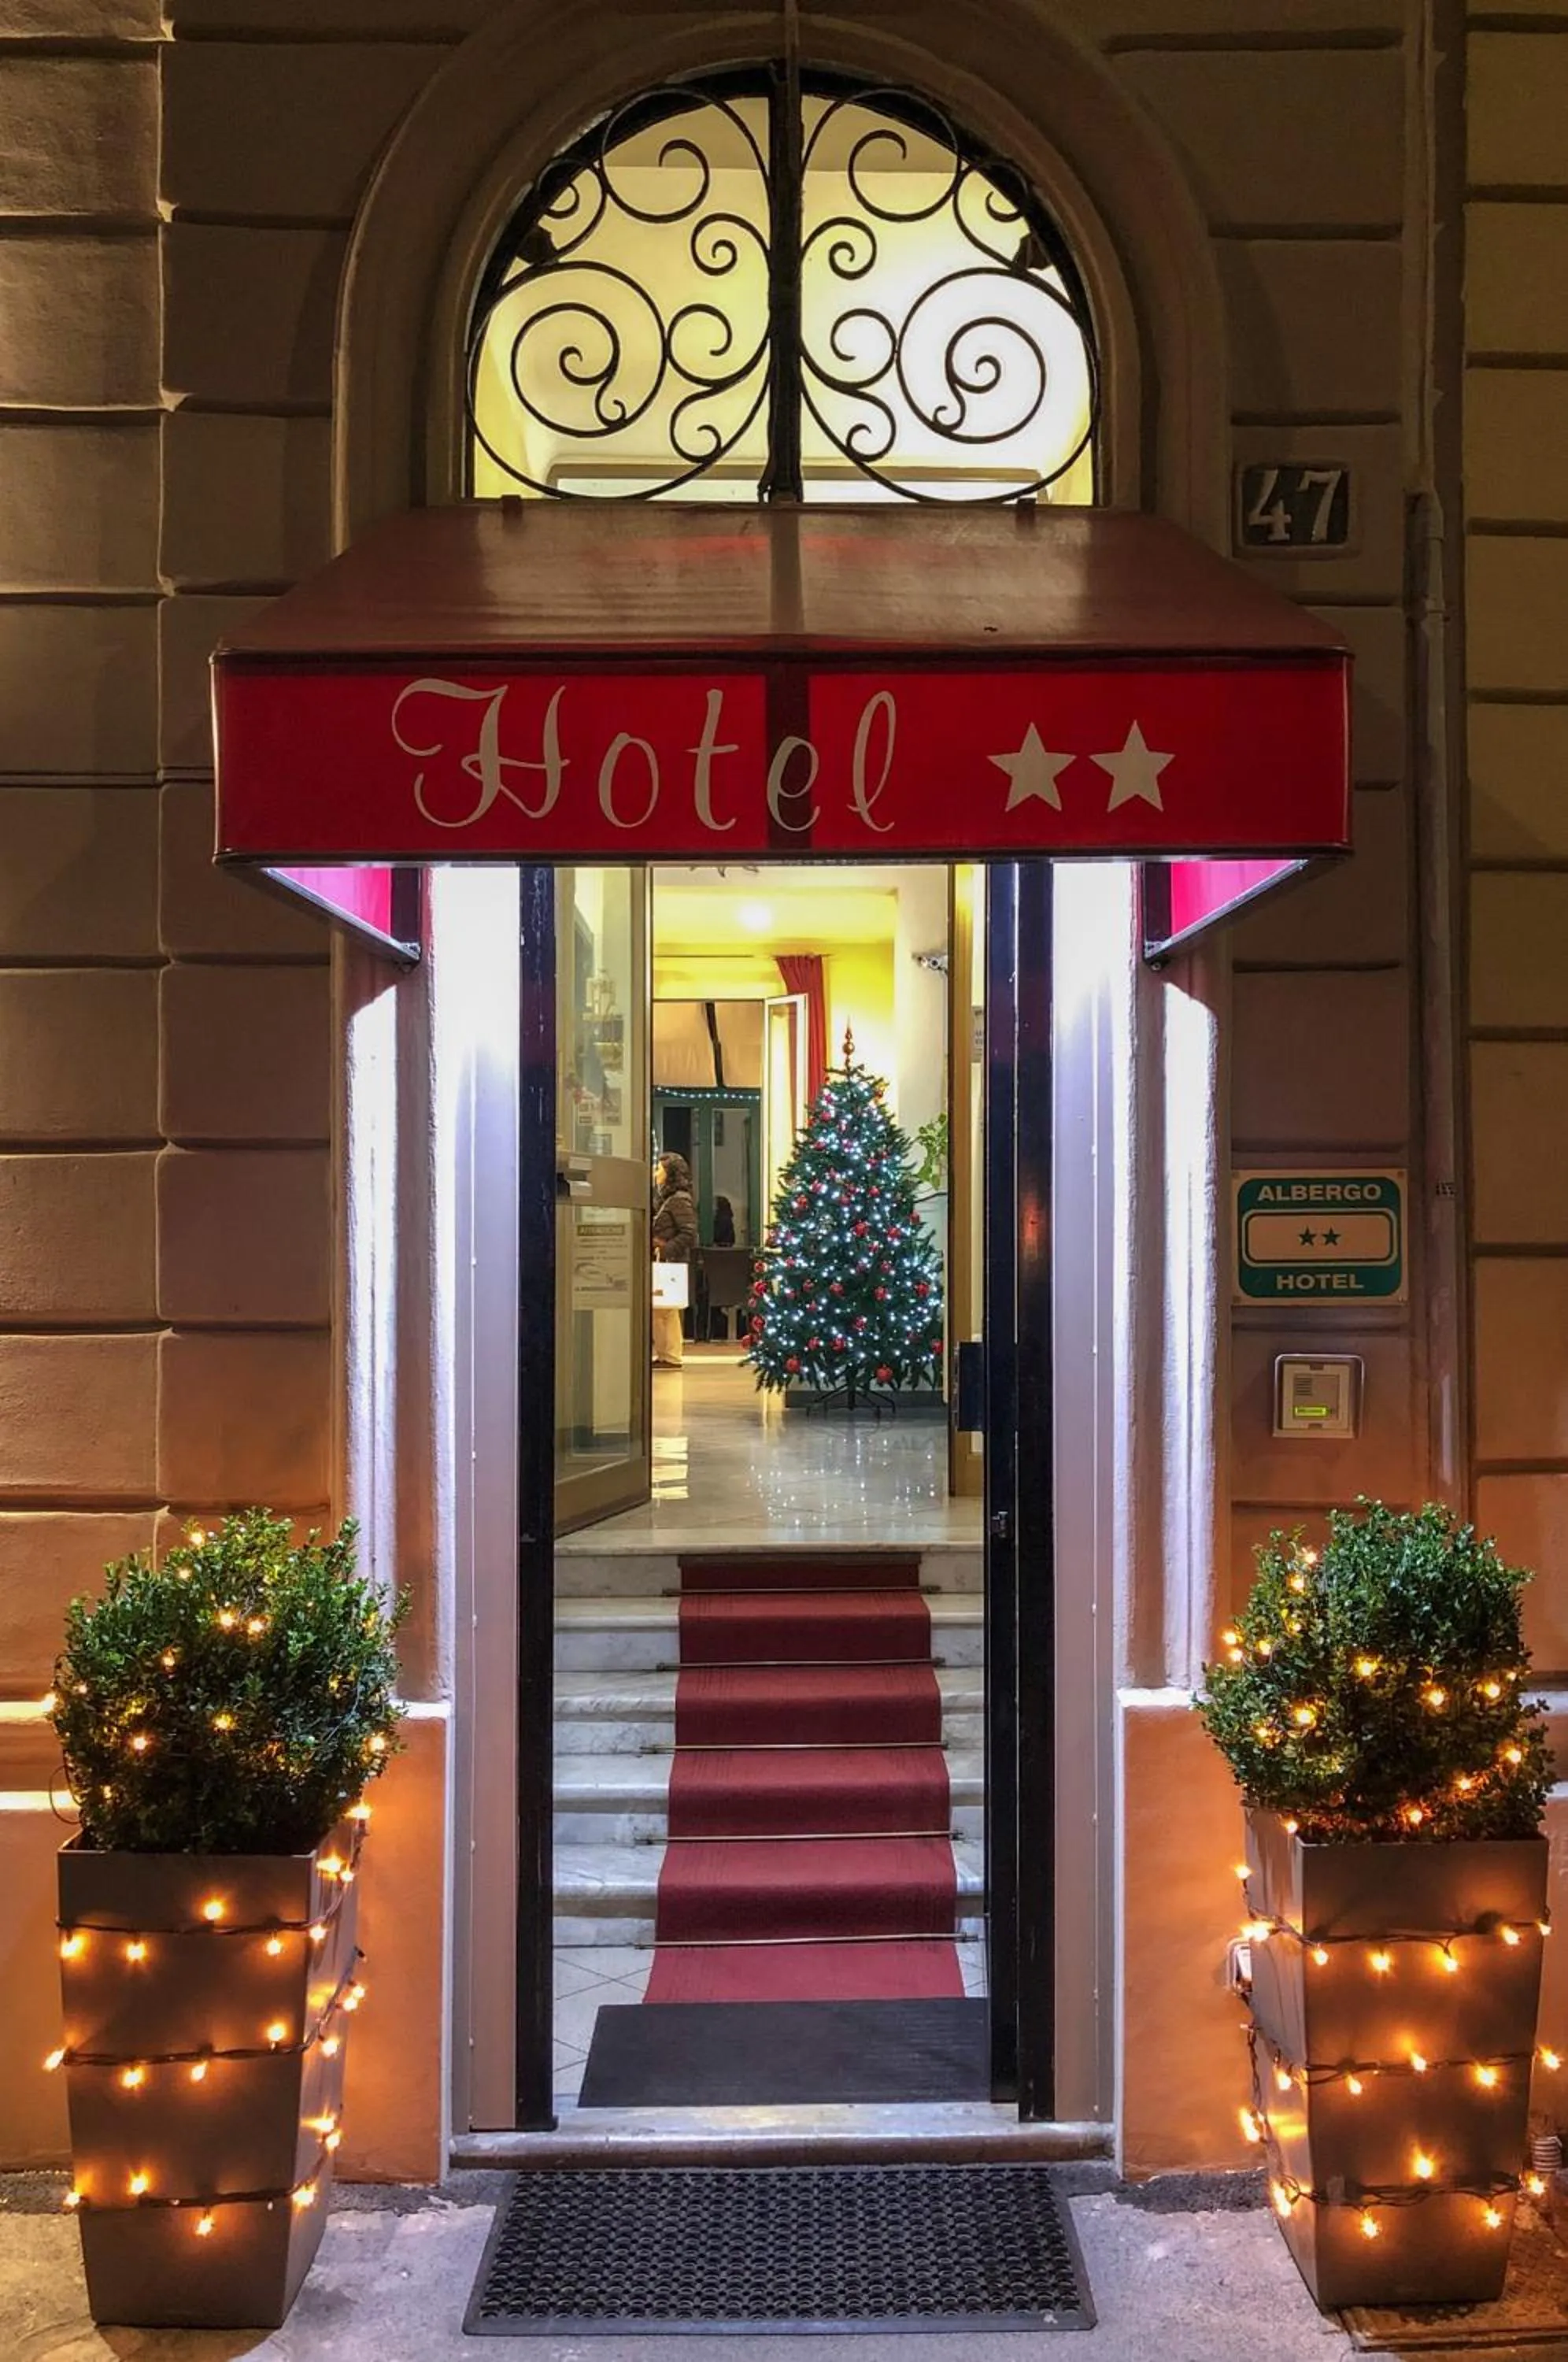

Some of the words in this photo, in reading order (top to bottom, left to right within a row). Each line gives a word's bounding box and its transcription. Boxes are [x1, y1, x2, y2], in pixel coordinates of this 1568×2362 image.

[1248, 469, 1342, 542] 47
[391, 678, 897, 831] Hotel
[1257, 1183, 1381, 1201] ALBERGO
[1276, 1273, 1365, 1290] HOTEL
